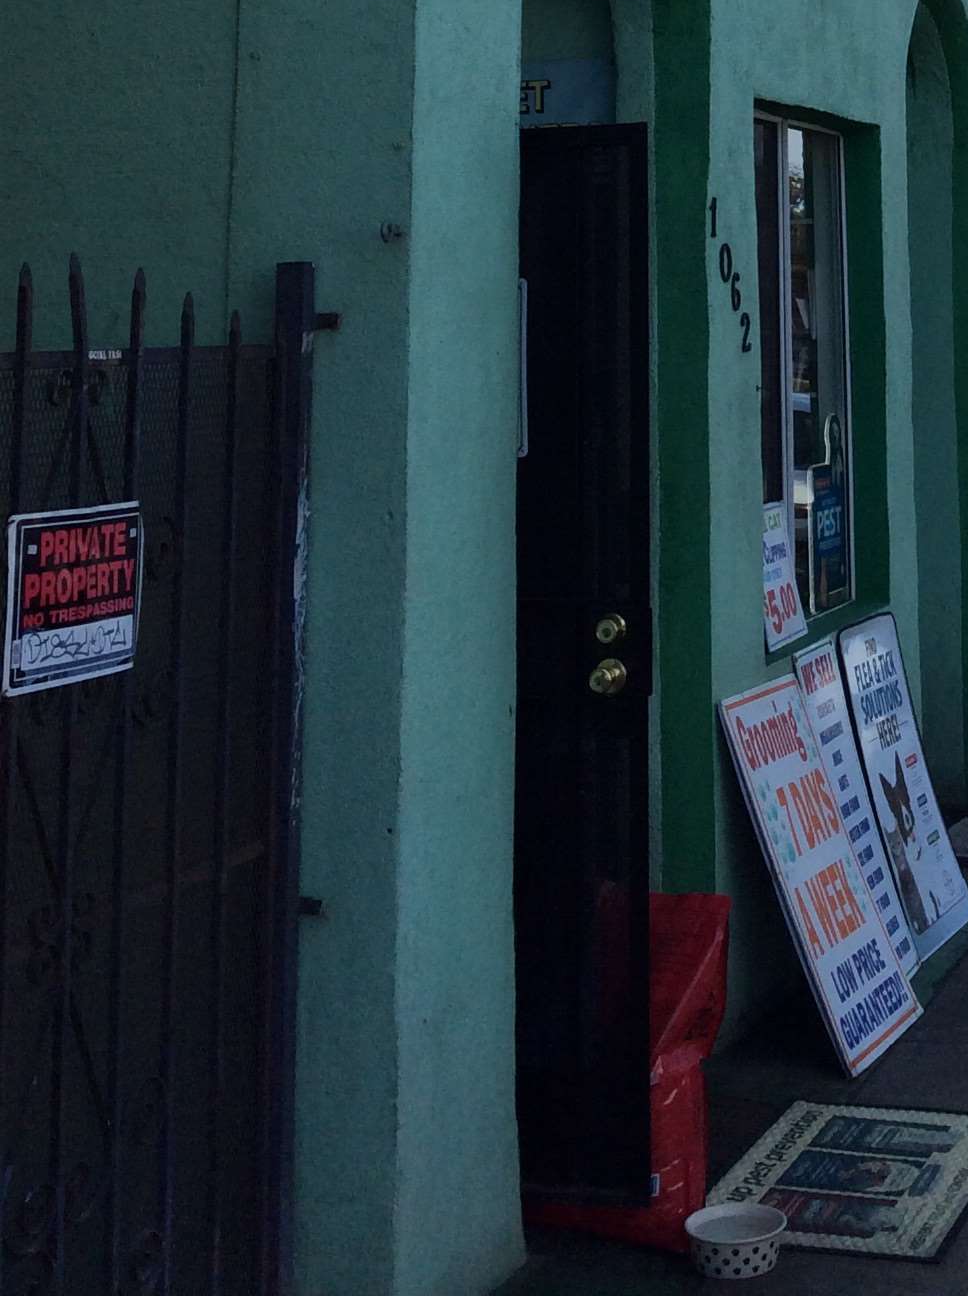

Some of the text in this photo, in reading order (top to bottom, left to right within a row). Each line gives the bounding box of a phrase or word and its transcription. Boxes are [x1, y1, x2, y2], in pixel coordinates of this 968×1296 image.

[39, 522, 128, 567] PRIVATE
[817, 506, 842, 540] PEST
[24, 559, 136, 609] PROPERTY
[23, 596, 134, 629] NO TRESPASSING
[801, 661, 817, 695] WE
[854, 660, 874, 692] FLEA
[878, 650, 897, 681] TICK
[860, 680, 903, 725] SOLUTIONS
[735, 701, 808, 772] Grooming
[877, 715, 901, 751] HERE!
[776, 768, 840, 856] 7 DAYS
[794, 859, 867, 960] A WEEK
[830, 957, 859, 1003] LOW
[851, 938, 886, 985] PRICE
[743, 1161, 777, 1186] pest
